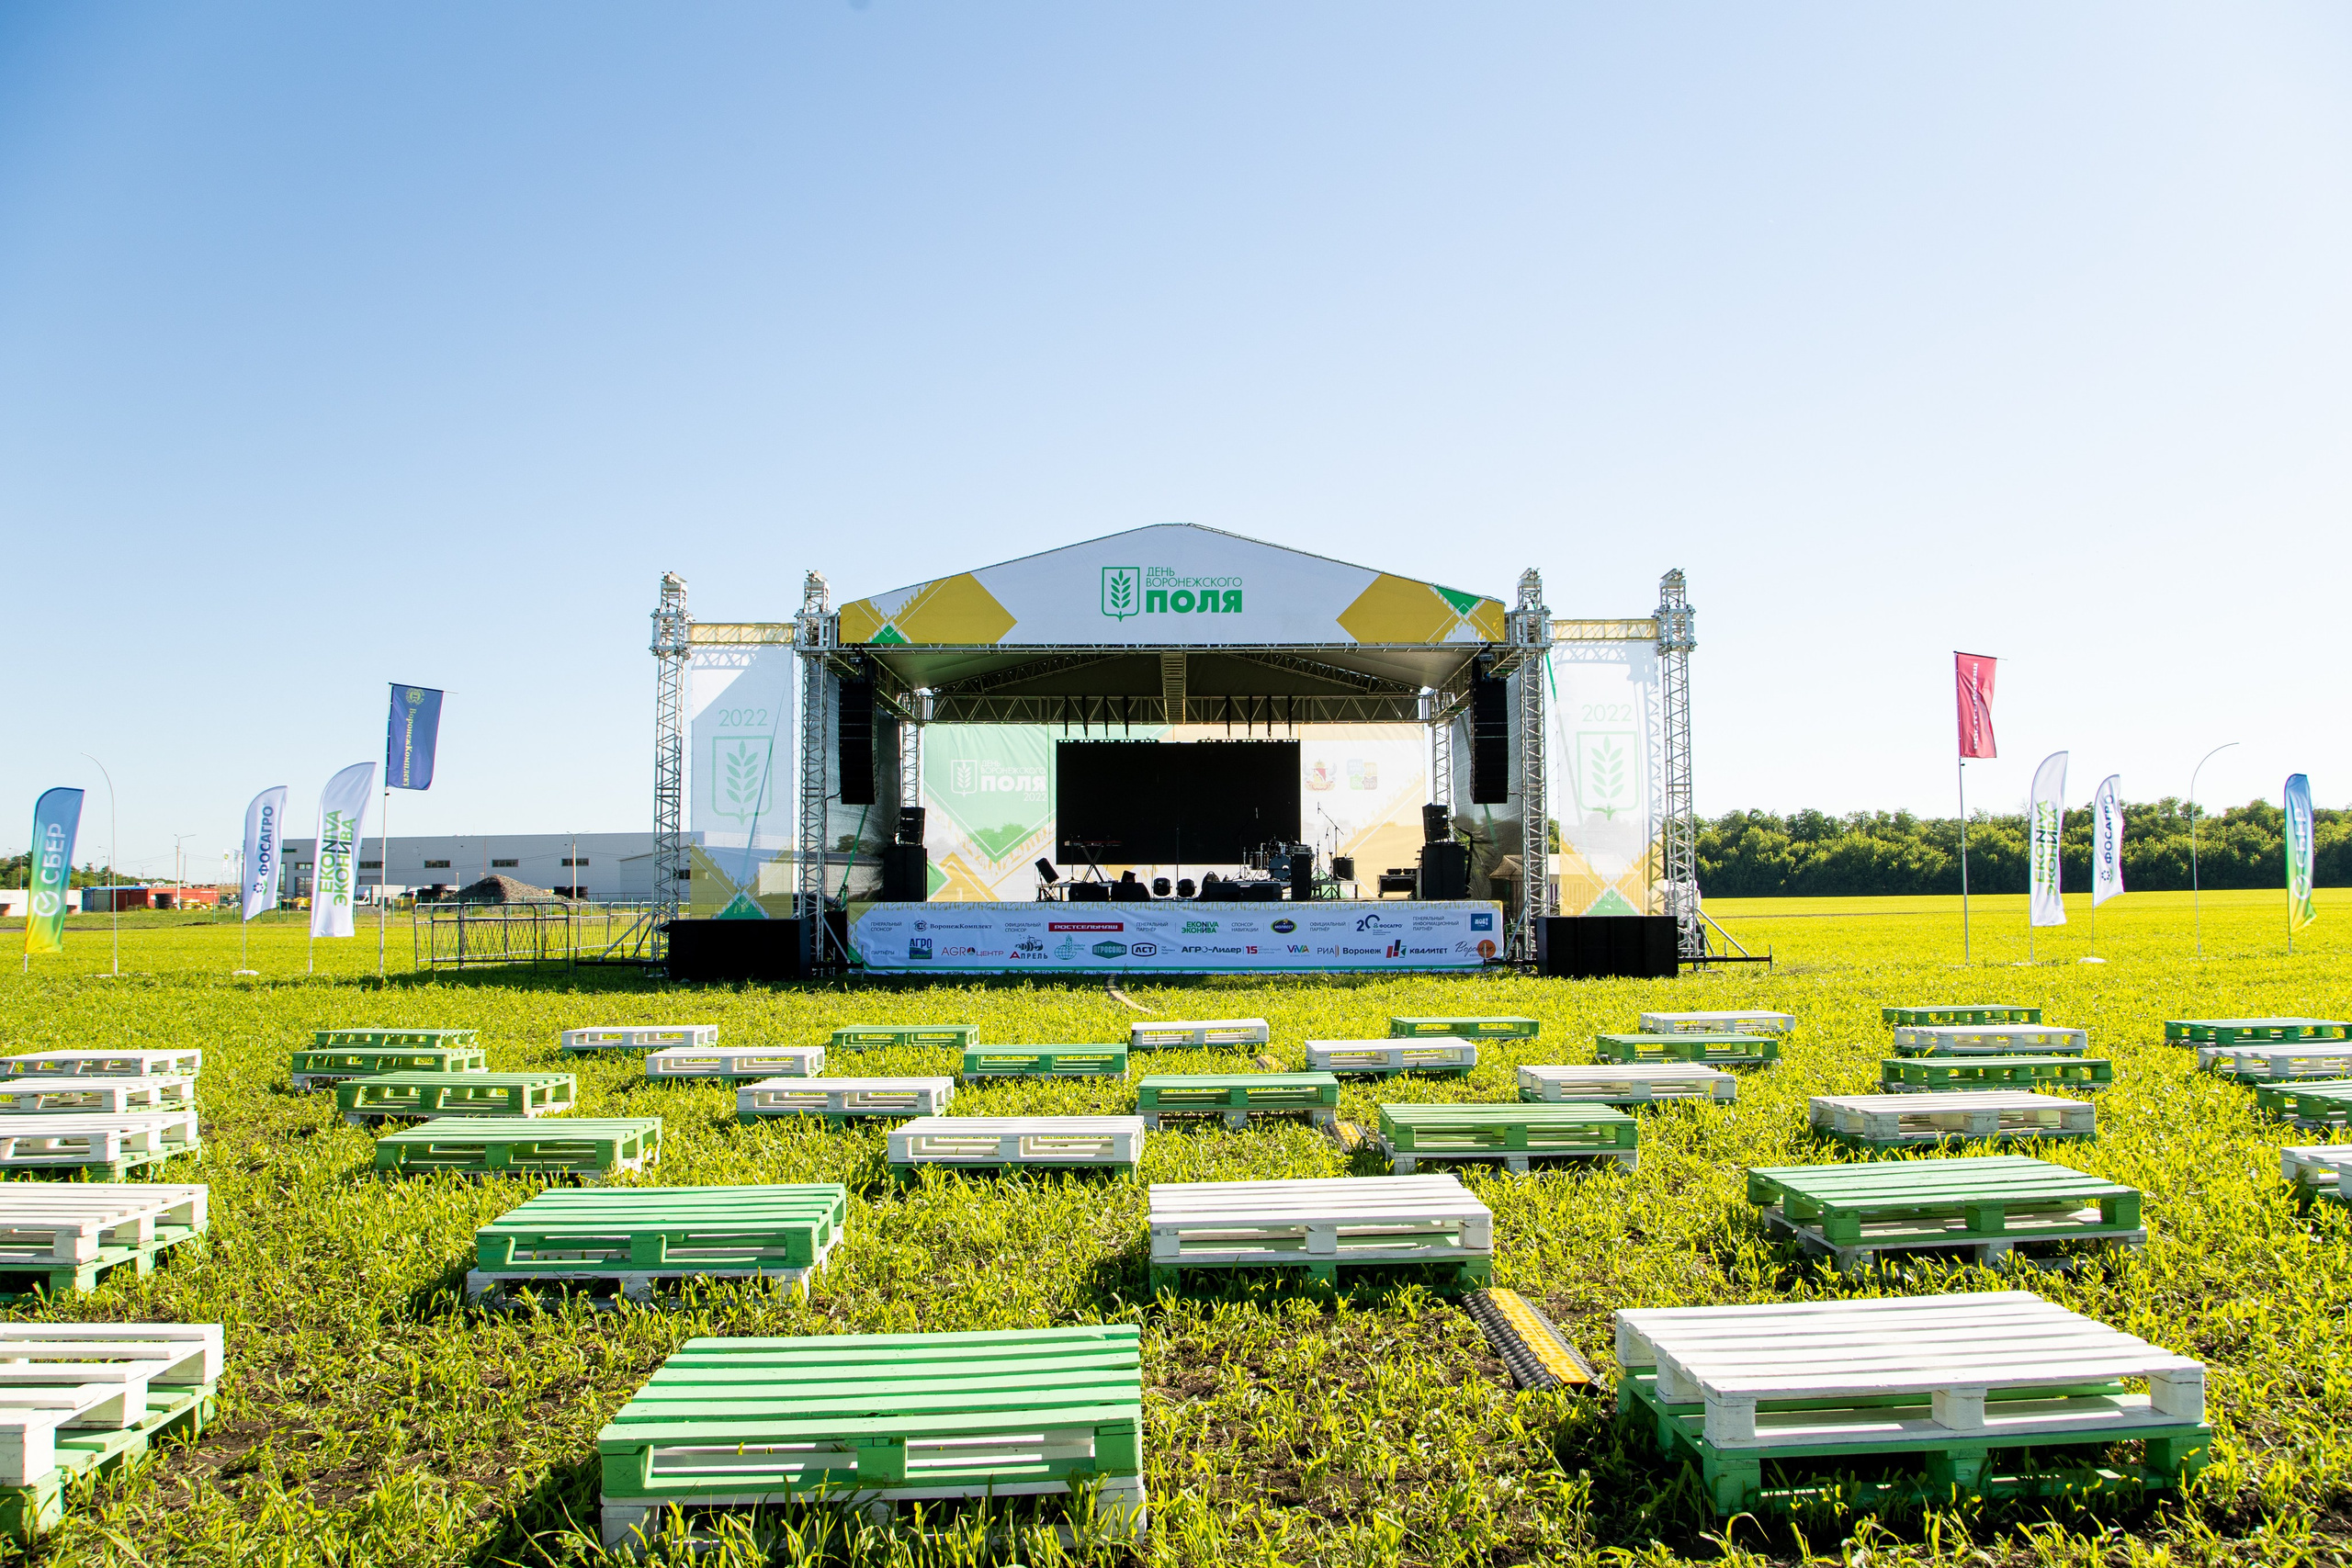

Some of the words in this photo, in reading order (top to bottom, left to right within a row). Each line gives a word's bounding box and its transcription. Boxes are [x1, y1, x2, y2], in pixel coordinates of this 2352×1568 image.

[1147, 567, 1175, 577] ДЕНЬ
[1146, 577, 1243, 588] ВОРОНЕЖСКОГО
[1146, 590, 1243, 614] ПОЛЯ
[718, 708, 768, 727] 2022
[1581, 704, 1633, 722] 2022
[981, 775, 1046, 792] ПОЛЯ
[1023, 793, 1047, 802] 2022
[2104, 794, 2114, 864] ФОСАГРО
[258, 806, 274, 876] ФОСАГРО
[2035, 799, 2048, 883] EKONIVA
[40, 823, 66, 885] СБЕР
[319, 809, 343, 893] EKONIVA
[2046, 807, 2058, 897] ЭКОНИВА
[333, 818, 356, 907] ЭКОНИВА
[909, 938, 933, 949] АГРО
[1245, 945, 1258, 954] 15
[1342, 947, 1382, 955] Воронеж
